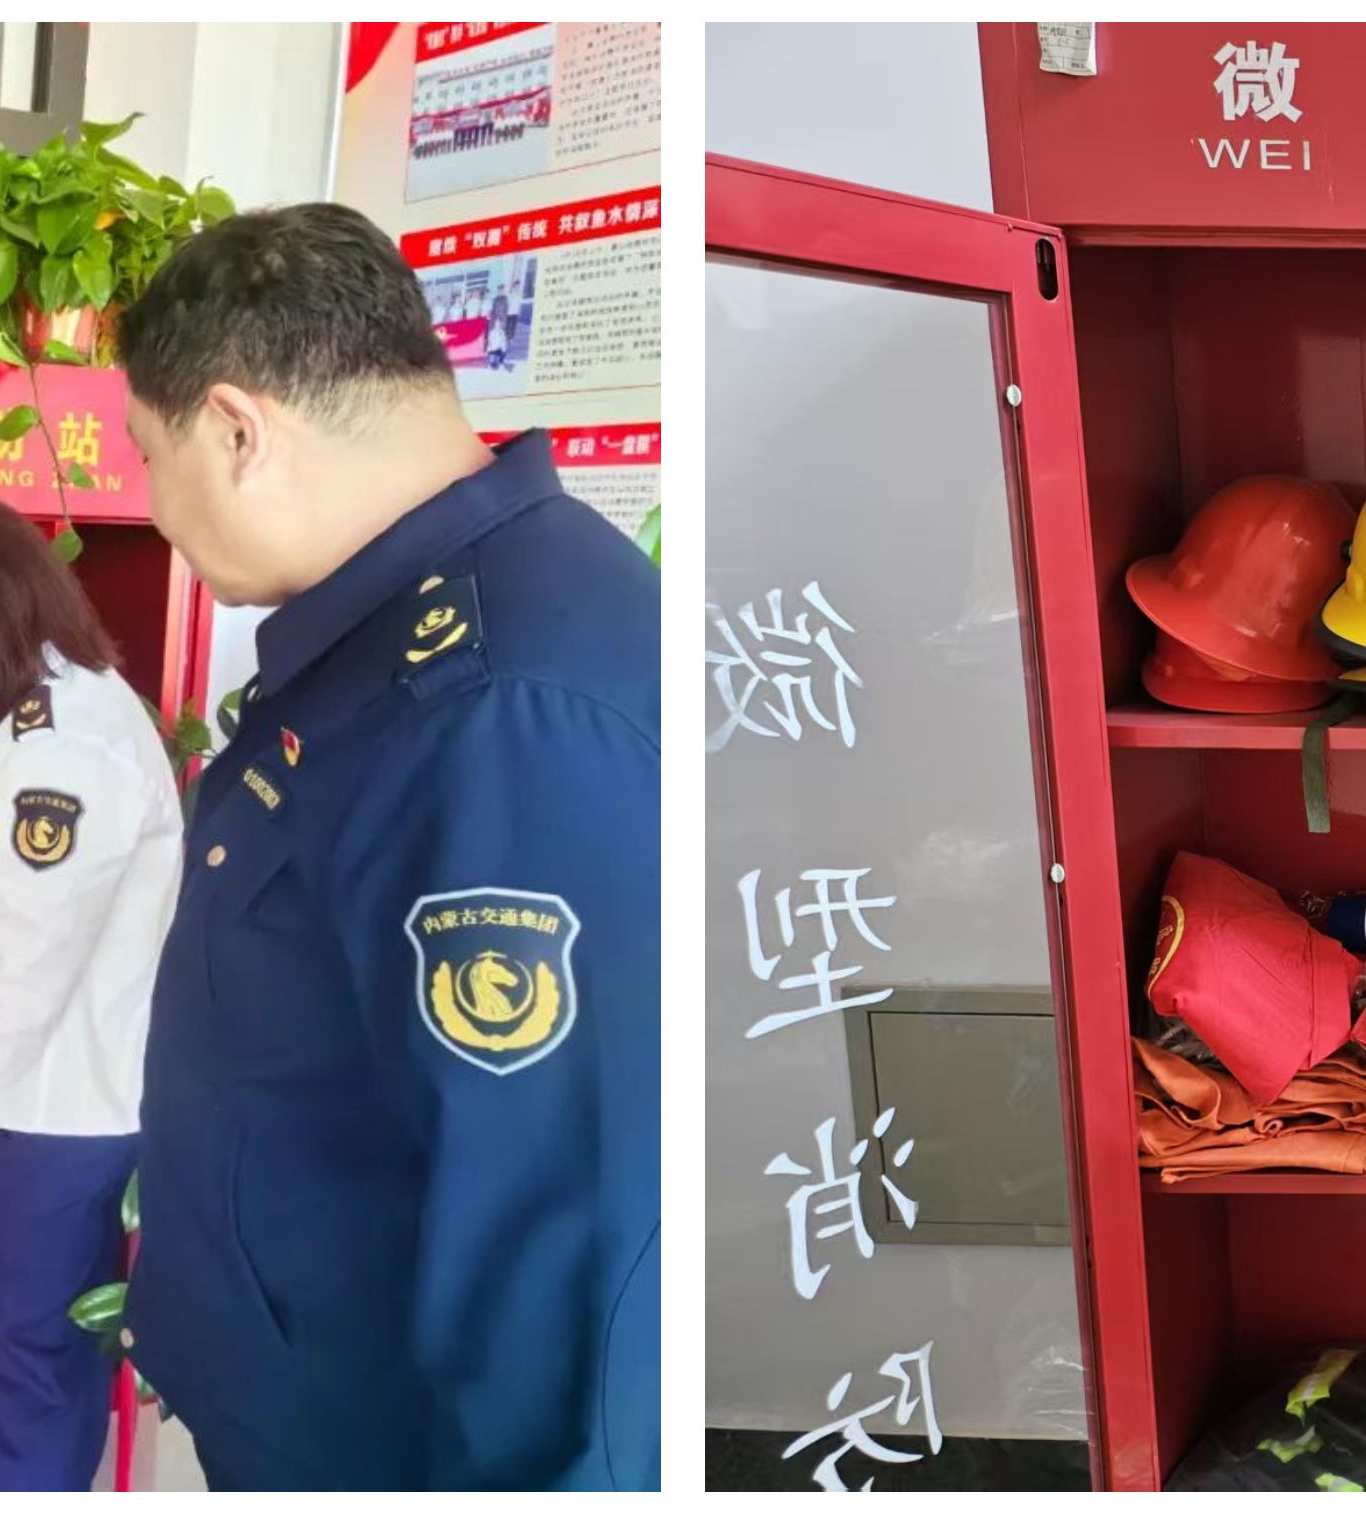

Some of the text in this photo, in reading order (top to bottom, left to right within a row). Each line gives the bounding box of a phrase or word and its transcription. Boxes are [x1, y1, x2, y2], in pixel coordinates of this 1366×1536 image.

[1200, 139, 1310, 169] WEI
[422, 907, 560, 936] 内蒙古交通集团
